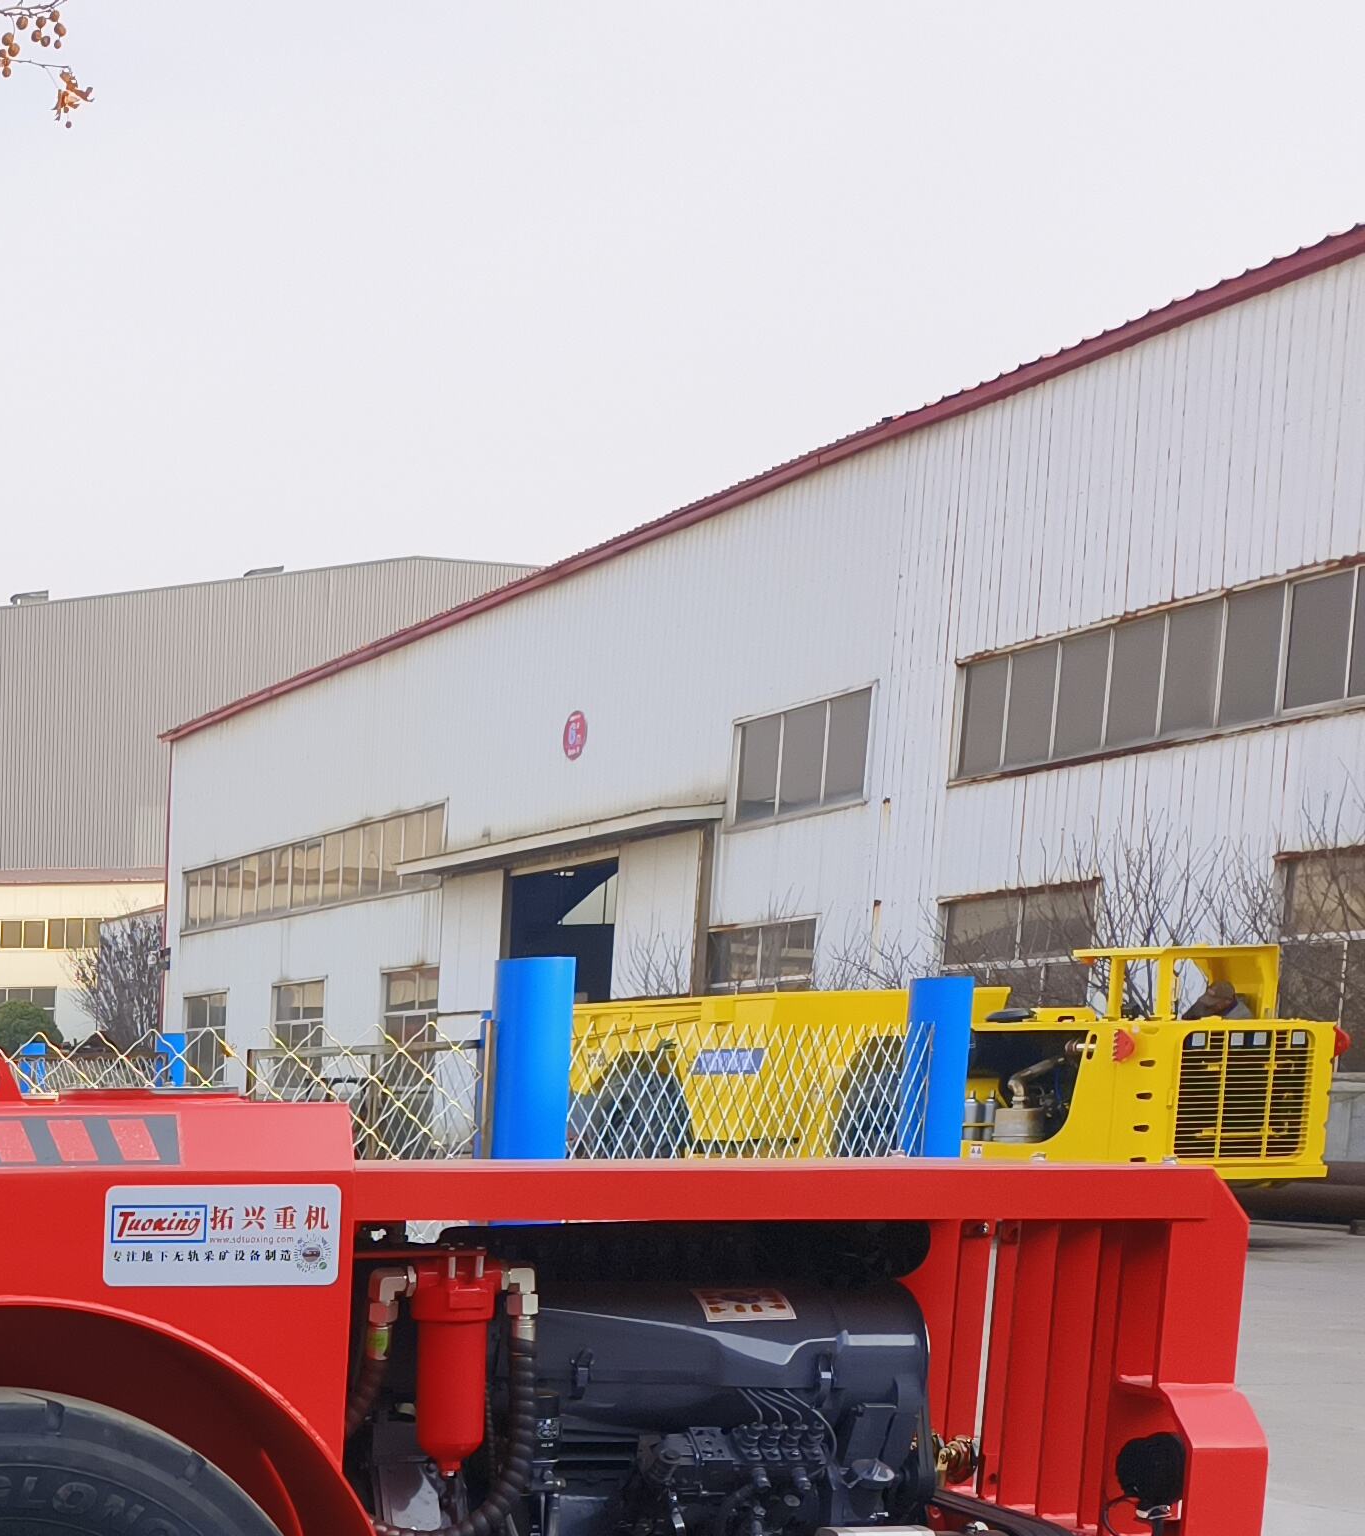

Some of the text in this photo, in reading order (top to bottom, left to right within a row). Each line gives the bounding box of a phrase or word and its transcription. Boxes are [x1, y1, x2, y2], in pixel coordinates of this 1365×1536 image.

[117, 1211, 201, 1238] Tuoxing
[209, 1205, 330, 1231] 拓兴重机
[113, 1249, 292, 1263] 专注地下无轨采矿设备制造
